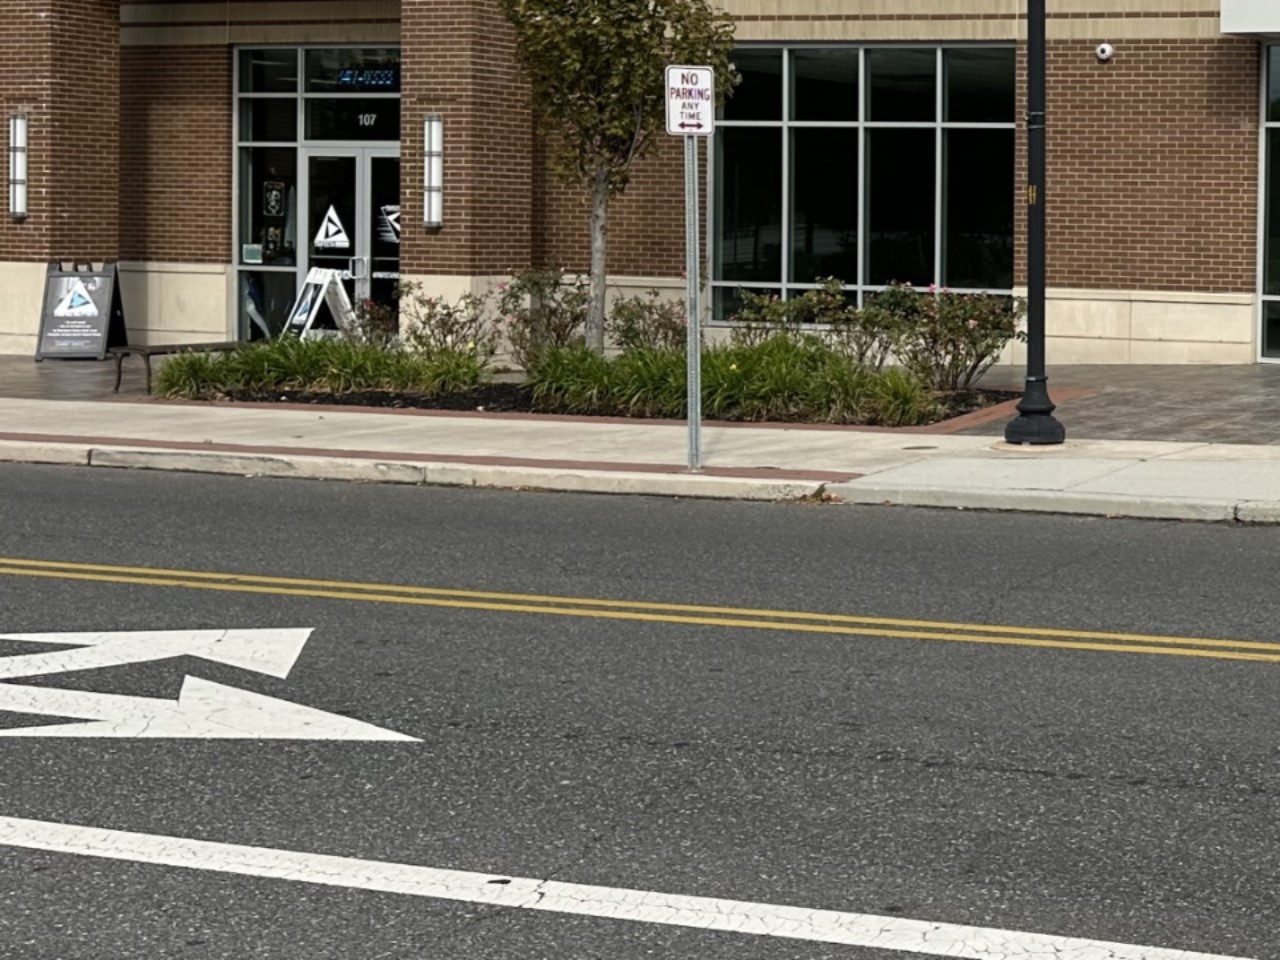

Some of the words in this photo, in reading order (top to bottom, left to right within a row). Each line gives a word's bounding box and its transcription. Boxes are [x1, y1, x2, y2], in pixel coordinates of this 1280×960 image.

[681, 72, 698, 85] NO
[670, 87, 710, 101] PARKING
[681, 102, 700, 110] ANY
[358, 113, 377, 126] 107
[680, 111, 701, 120] TIME
